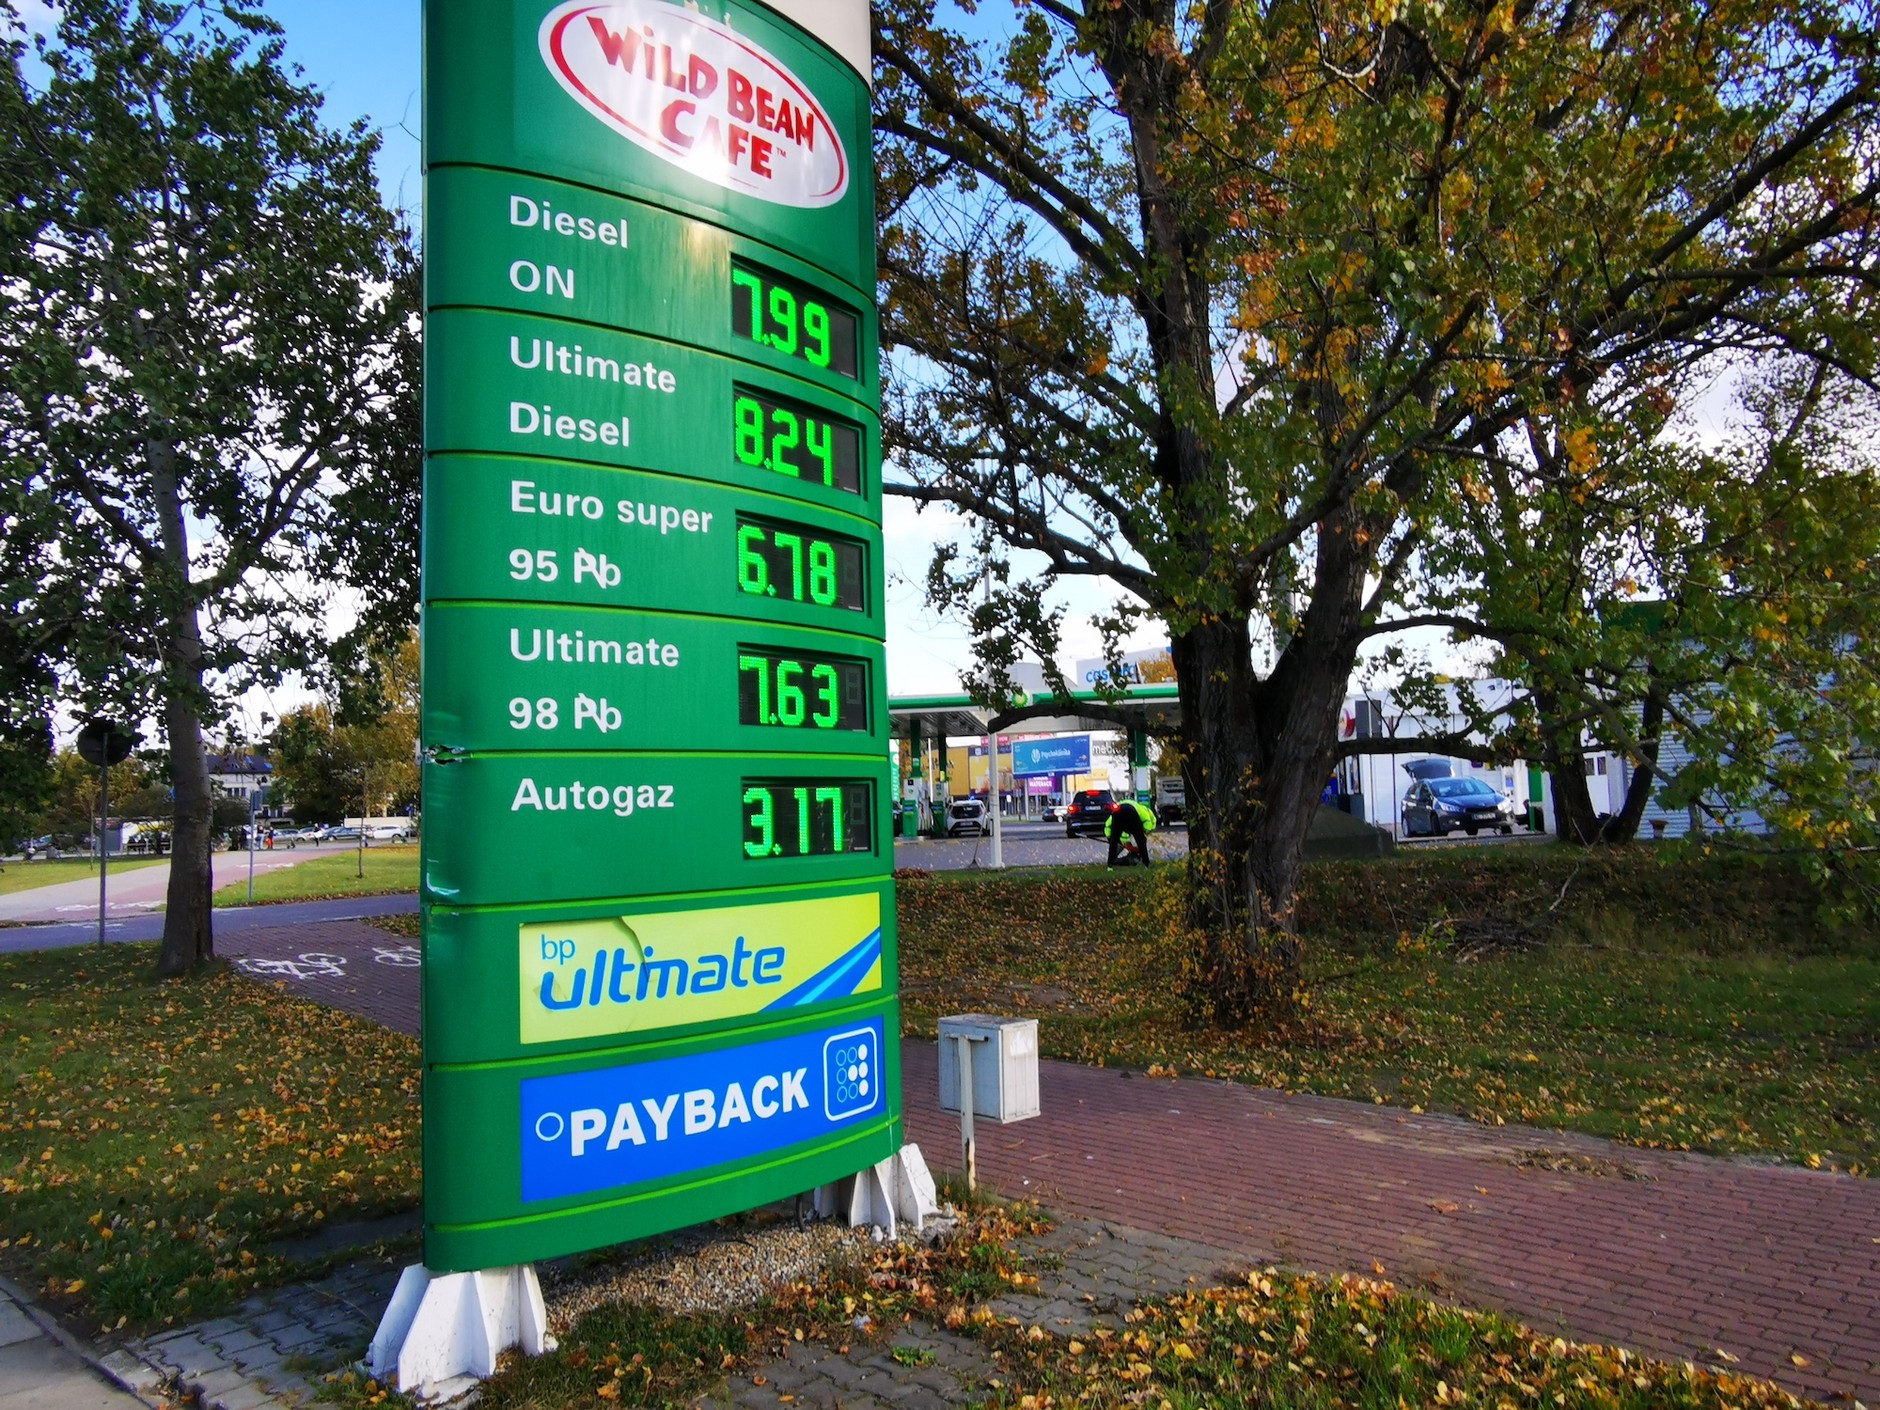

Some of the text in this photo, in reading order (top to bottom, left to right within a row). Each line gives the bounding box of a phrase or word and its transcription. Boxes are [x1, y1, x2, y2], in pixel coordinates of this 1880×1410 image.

[659, 98, 773, 180] CAFE
[727, 68, 815, 153] BEAN
[510, 195, 628, 249] Diesel
[509, 260, 575, 299] ON
[732, 268, 831, 368] 7.99
[511, 336, 677, 393] Ultimate
[510, 402, 630, 448] Diesel
[734, 396, 833, 487] 8.24
[511, 480, 713, 535] Euro super
[509, 548, 559, 582] 95
[737, 524, 836, 606] 6.78
[510, 628, 680, 667] Ultimate
[509, 697, 559, 730] 98
[739, 655, 839, 729] 7.63
[511, 778, 675, 817] Autogaz
[743, 787, 844, 857] 3.17
[539, 936, 787, 1011] ultimate
[540, 933, 576, 965] bp
[570, 1067, 810, 1157] PAYBACK
